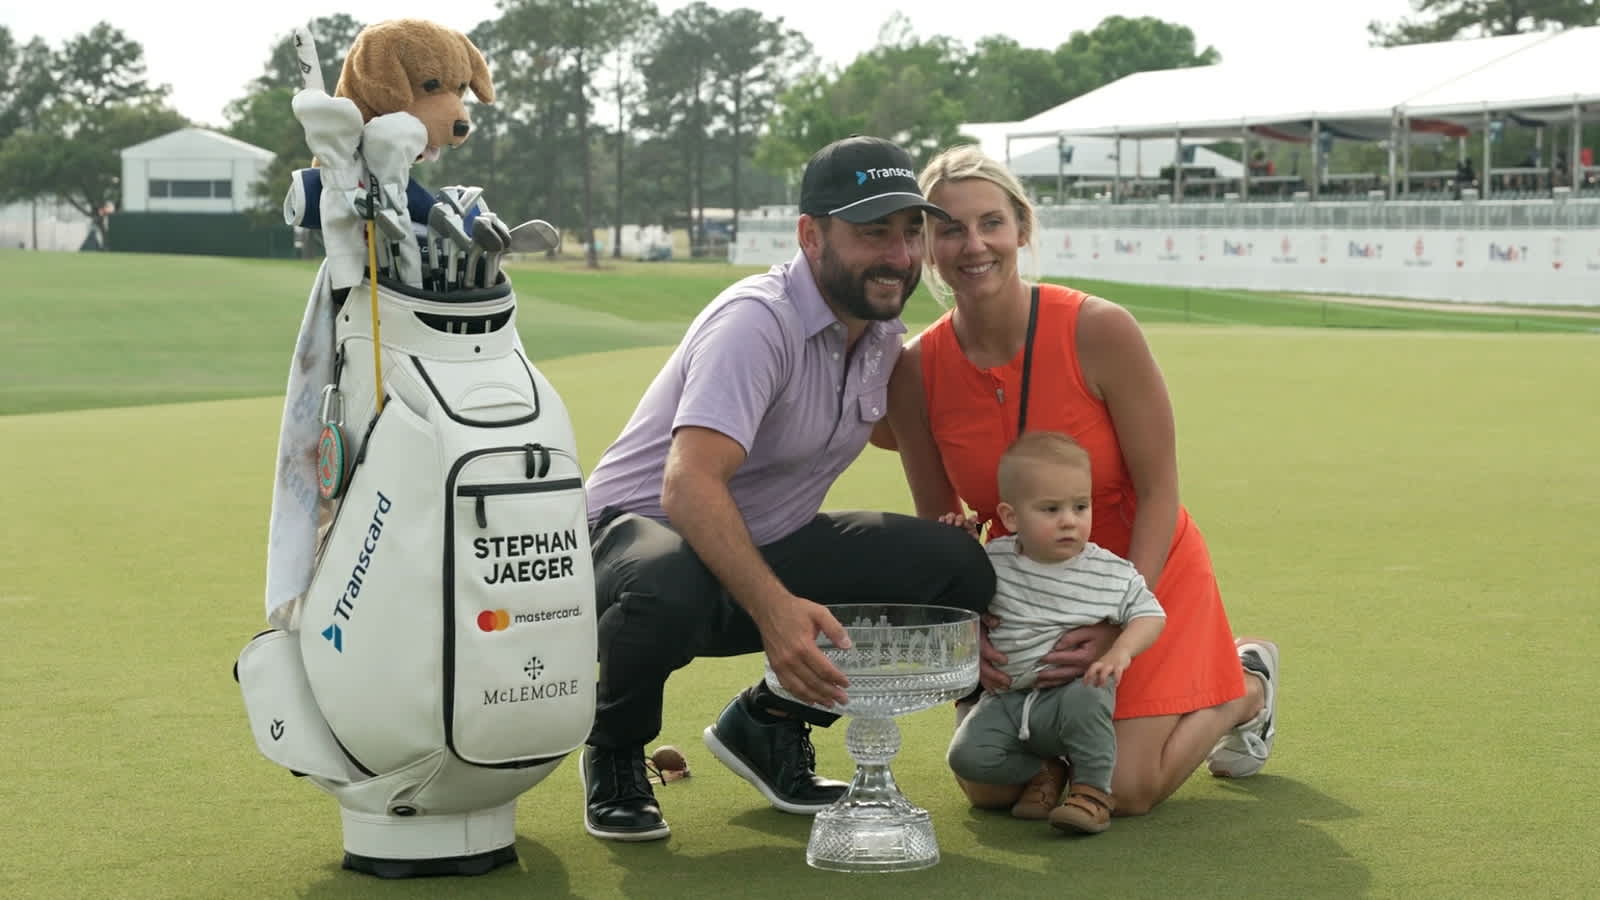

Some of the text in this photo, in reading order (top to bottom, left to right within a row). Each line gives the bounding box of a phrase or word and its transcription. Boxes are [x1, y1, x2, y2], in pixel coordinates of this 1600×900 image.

[334, 491, 392, 621] Transcard
[473, 529, 577, 559] STEPHAN
[484, 556, 574, 584] JAEGER
[483, 680, 578, 705] McLEMORE
